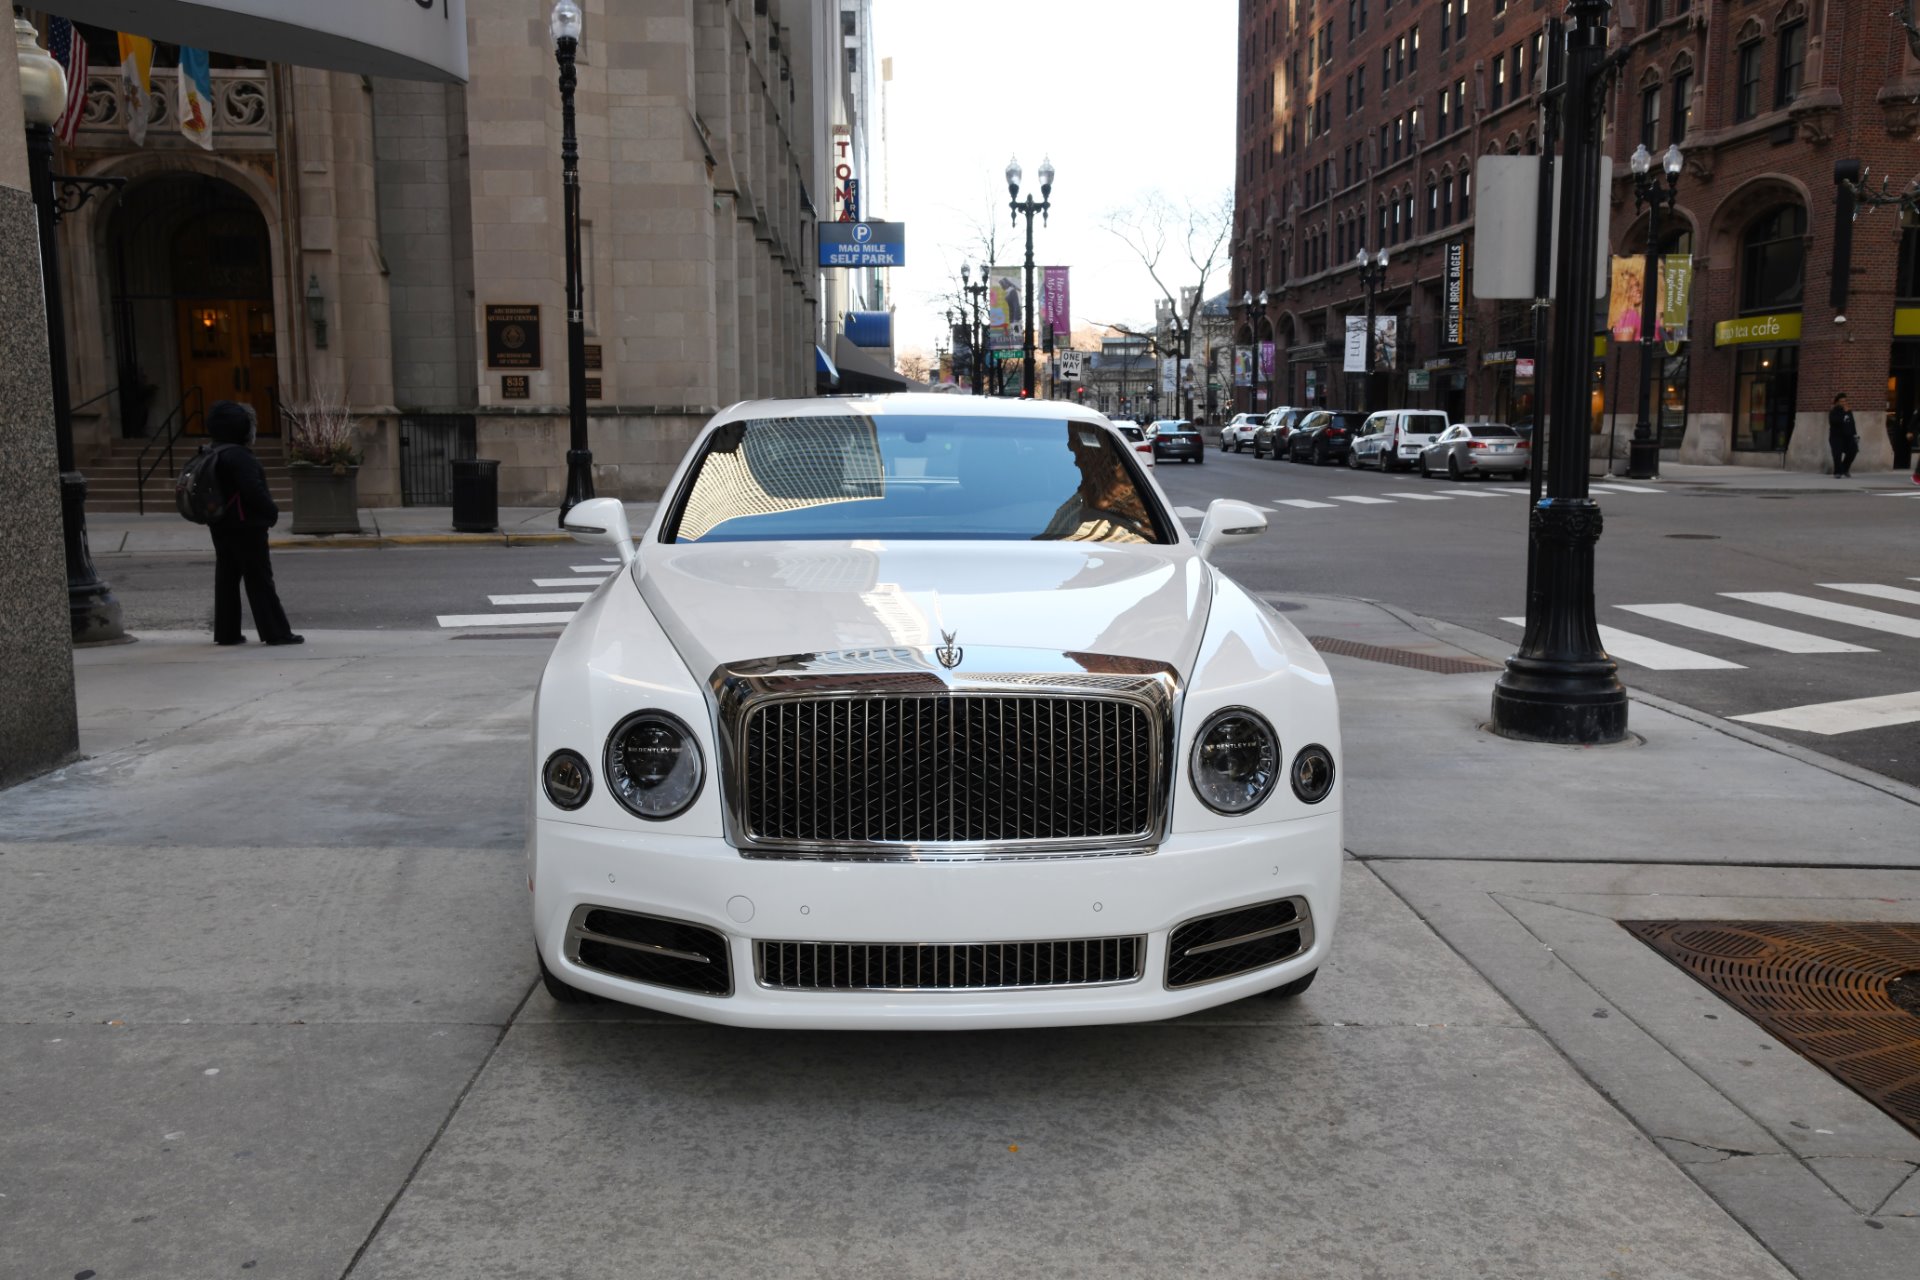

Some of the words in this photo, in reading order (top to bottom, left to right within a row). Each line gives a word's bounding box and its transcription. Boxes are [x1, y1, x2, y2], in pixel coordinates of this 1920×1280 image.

[857, 227, 868, 240] P
[839, 244, 860, 252] MAG
[862, 244, 886, 252] MILE
[830, 254, 859, 264] SELF
[862, 254, 894, 264] PARK
[1451, 244, 1462, 278] BAGELS
[1046, 277, 1055, 291] My
[1056, 277, 1065, 291] Her
[1675, 269, 1686, 305] Everyday
[1736, 325, 1748, 338] tea
[1751, 316, 1780, 337] café
[1063, 352, 1080, 361] ONE
[1062, 361, 1080, 370] WAY
[506, 377, 525, 387] 835
